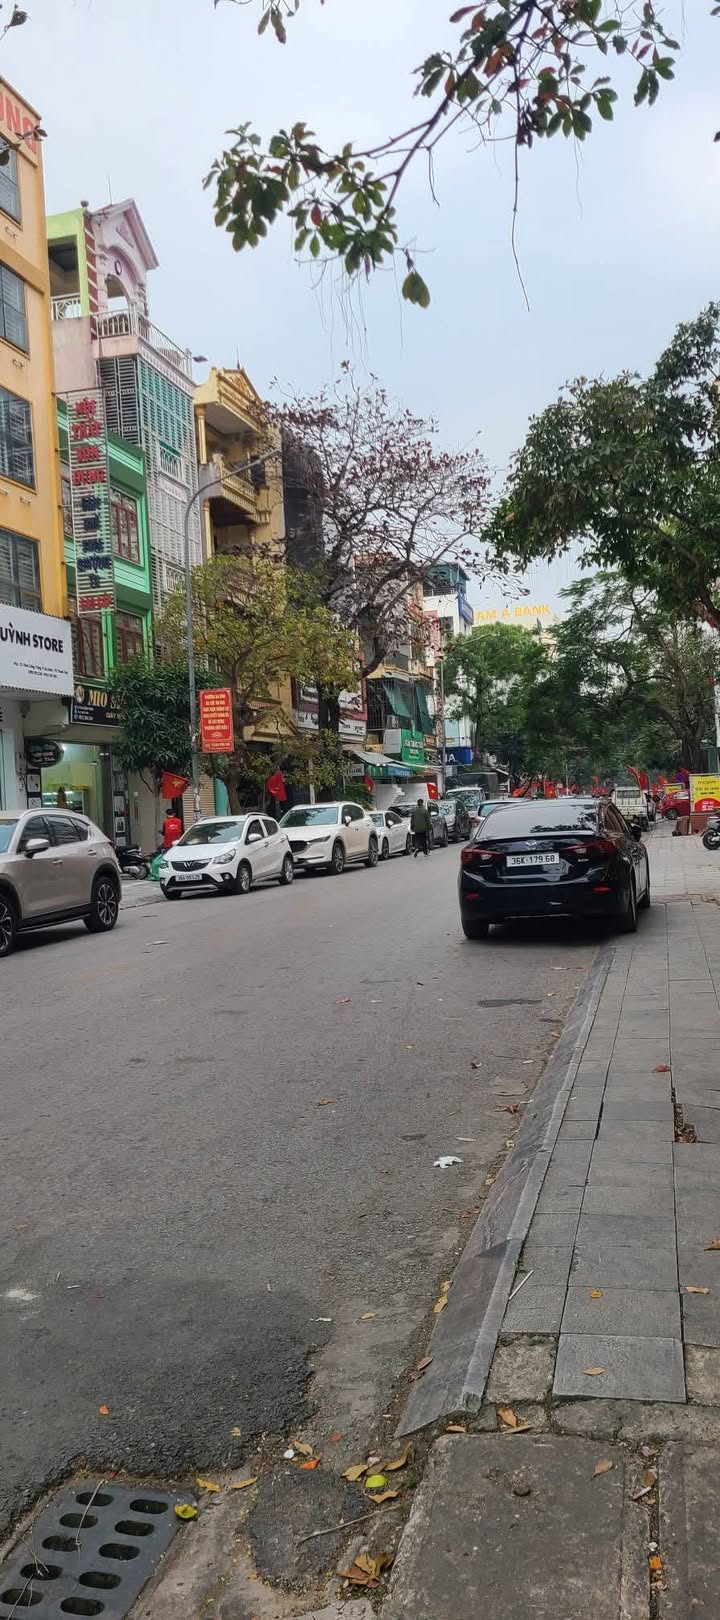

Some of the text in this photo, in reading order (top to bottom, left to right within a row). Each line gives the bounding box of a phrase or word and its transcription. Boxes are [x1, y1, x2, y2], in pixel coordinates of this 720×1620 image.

[473, 608, 497, 621] AM
[501, 608, 510, 618] A
[514, 604, 550, 617] BANK
[32, 633, 64, 653] STORE
[88, 689, 108, 708] MIO
[511, 854, 556, 865] 36K-179.68
